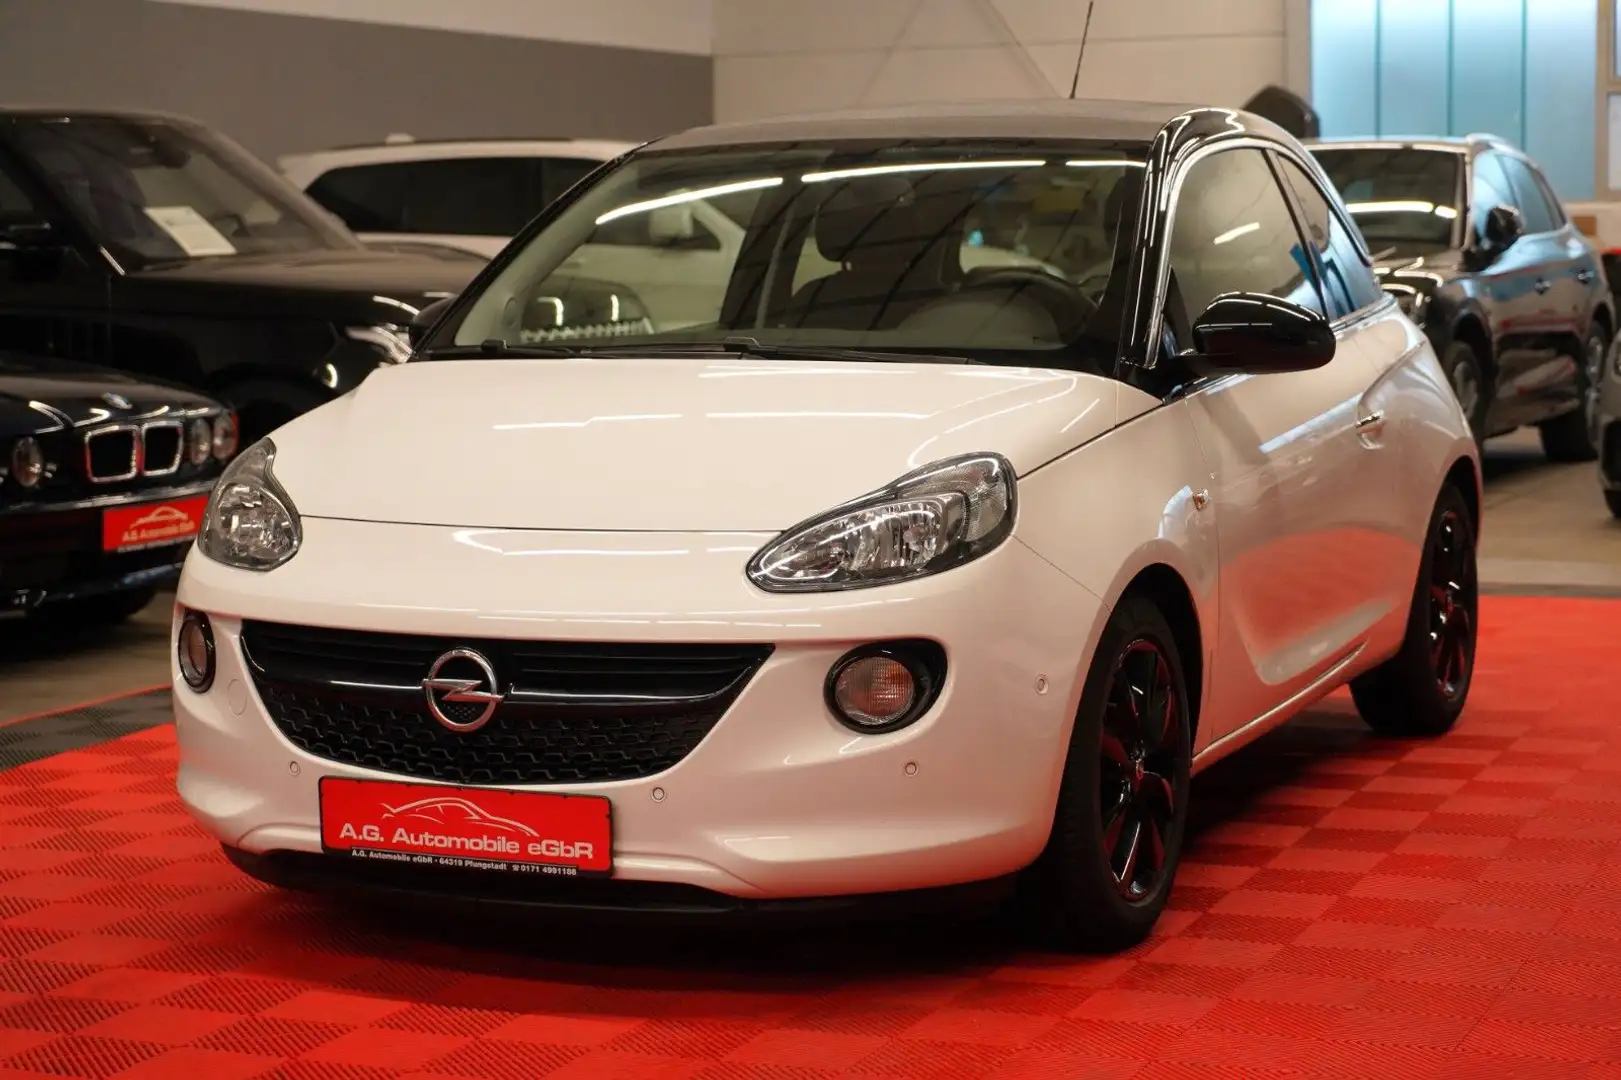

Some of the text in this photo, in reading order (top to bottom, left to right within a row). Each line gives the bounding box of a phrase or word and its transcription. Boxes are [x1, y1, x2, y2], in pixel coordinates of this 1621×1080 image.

[339, 822, 594, 859] A.G. Automobile eGbR
[351, 849, 367, 858] A.G.
[369, 851, 411, 862] Automobile
[412, 855, 433, 864] eGbR
[439, 857, 463, 867] 64319
[464, 859, 508, 871] Pfungstadt
[520, 864, 540, 873] 0171
